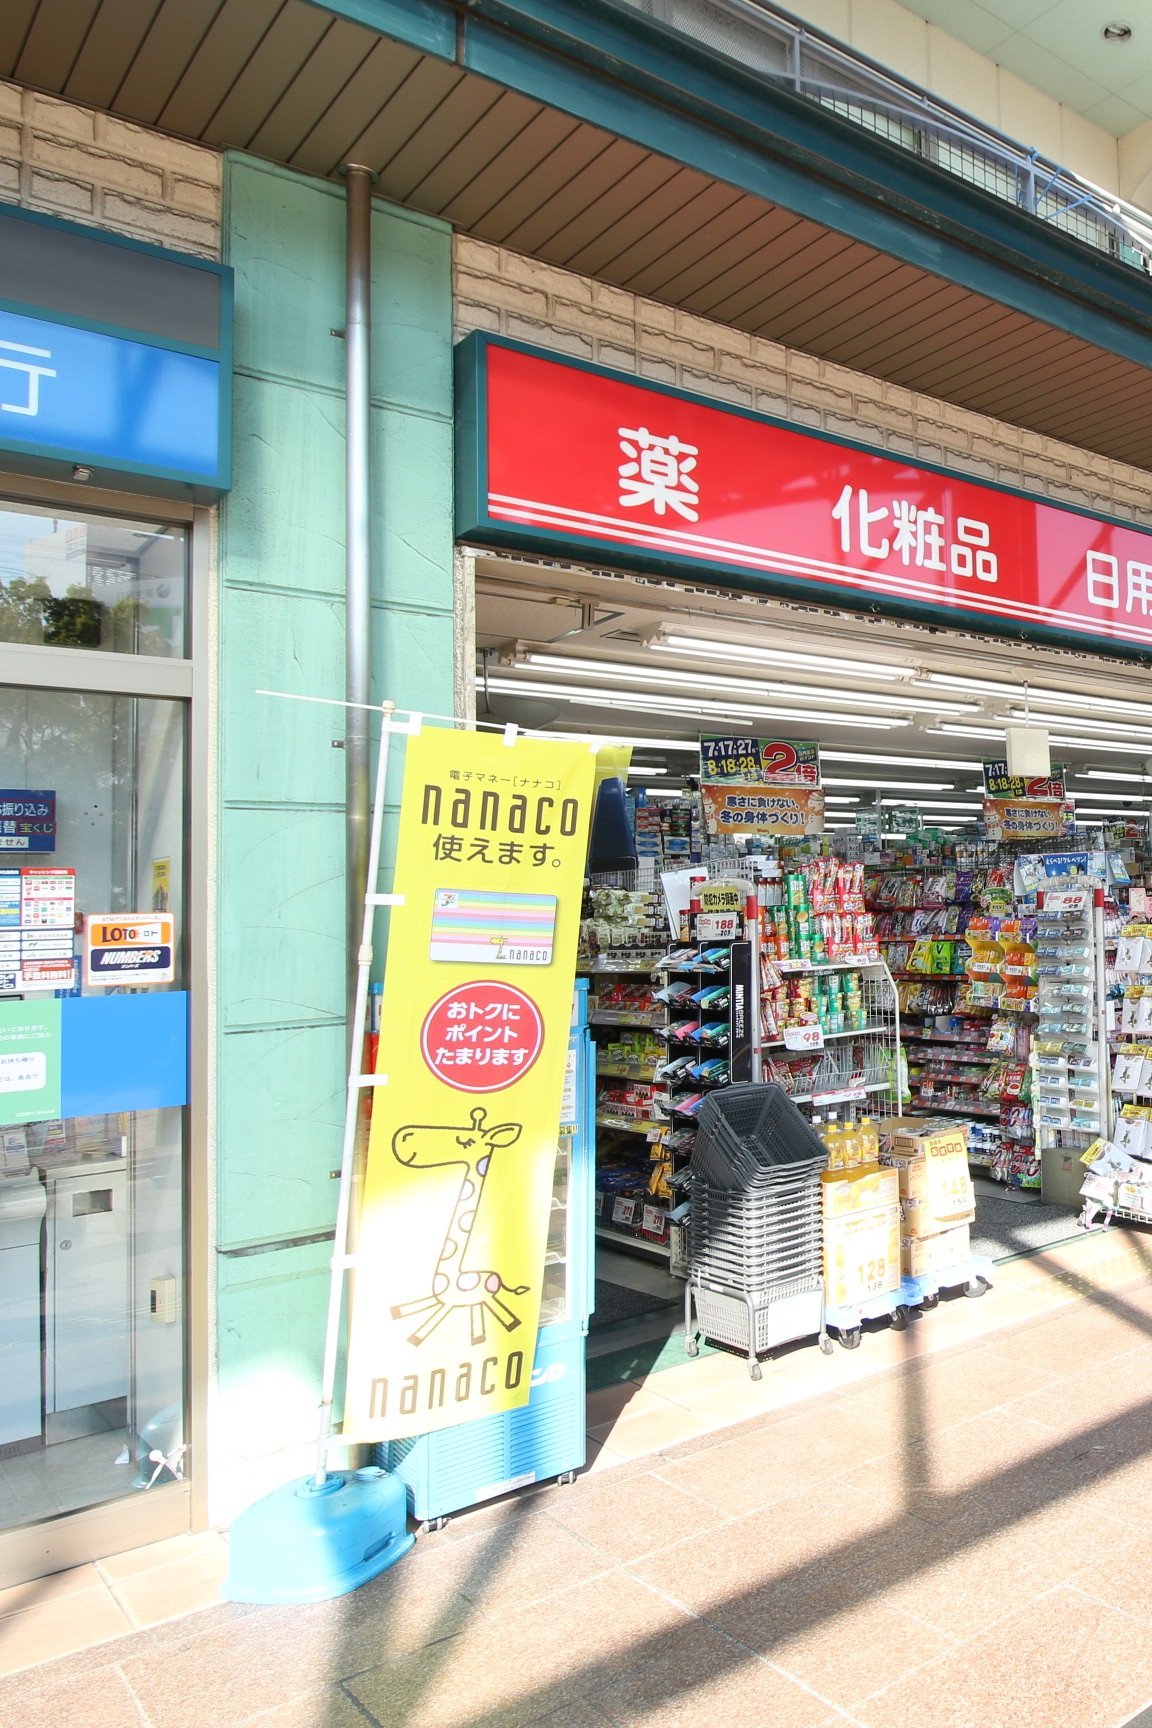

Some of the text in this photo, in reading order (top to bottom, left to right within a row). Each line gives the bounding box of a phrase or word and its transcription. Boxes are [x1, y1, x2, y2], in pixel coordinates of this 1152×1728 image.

[617, 426, 699, 523] 薬
[831, 484, 998, 583] 化粧品
[421, 783, 580, 837] nanaco
[726, 795, 800, 810] 寒さに負けない、
[720, 810, 806, 826] 冬の身体づくり!
[432, 833, 562, 868] 使えます。
[1062, 896, 1083, 904] 88
[715, 919, 734, 930] 188
[101, 926, 136, 943] LOTO
[100, 949, 162, 966] NUMBERS
[508, 948, 549, 962] nanaco
[447, 1001, 521, 1021] おトクに
[444, 1023, 519, 1043] ポイント
[803, 1031, 820, 1042] 98
[434, 1047, 529, 1066] たまります
[857, 1258, 886, 1284] 128
[368, 1350, 524, 1420] nanaco
